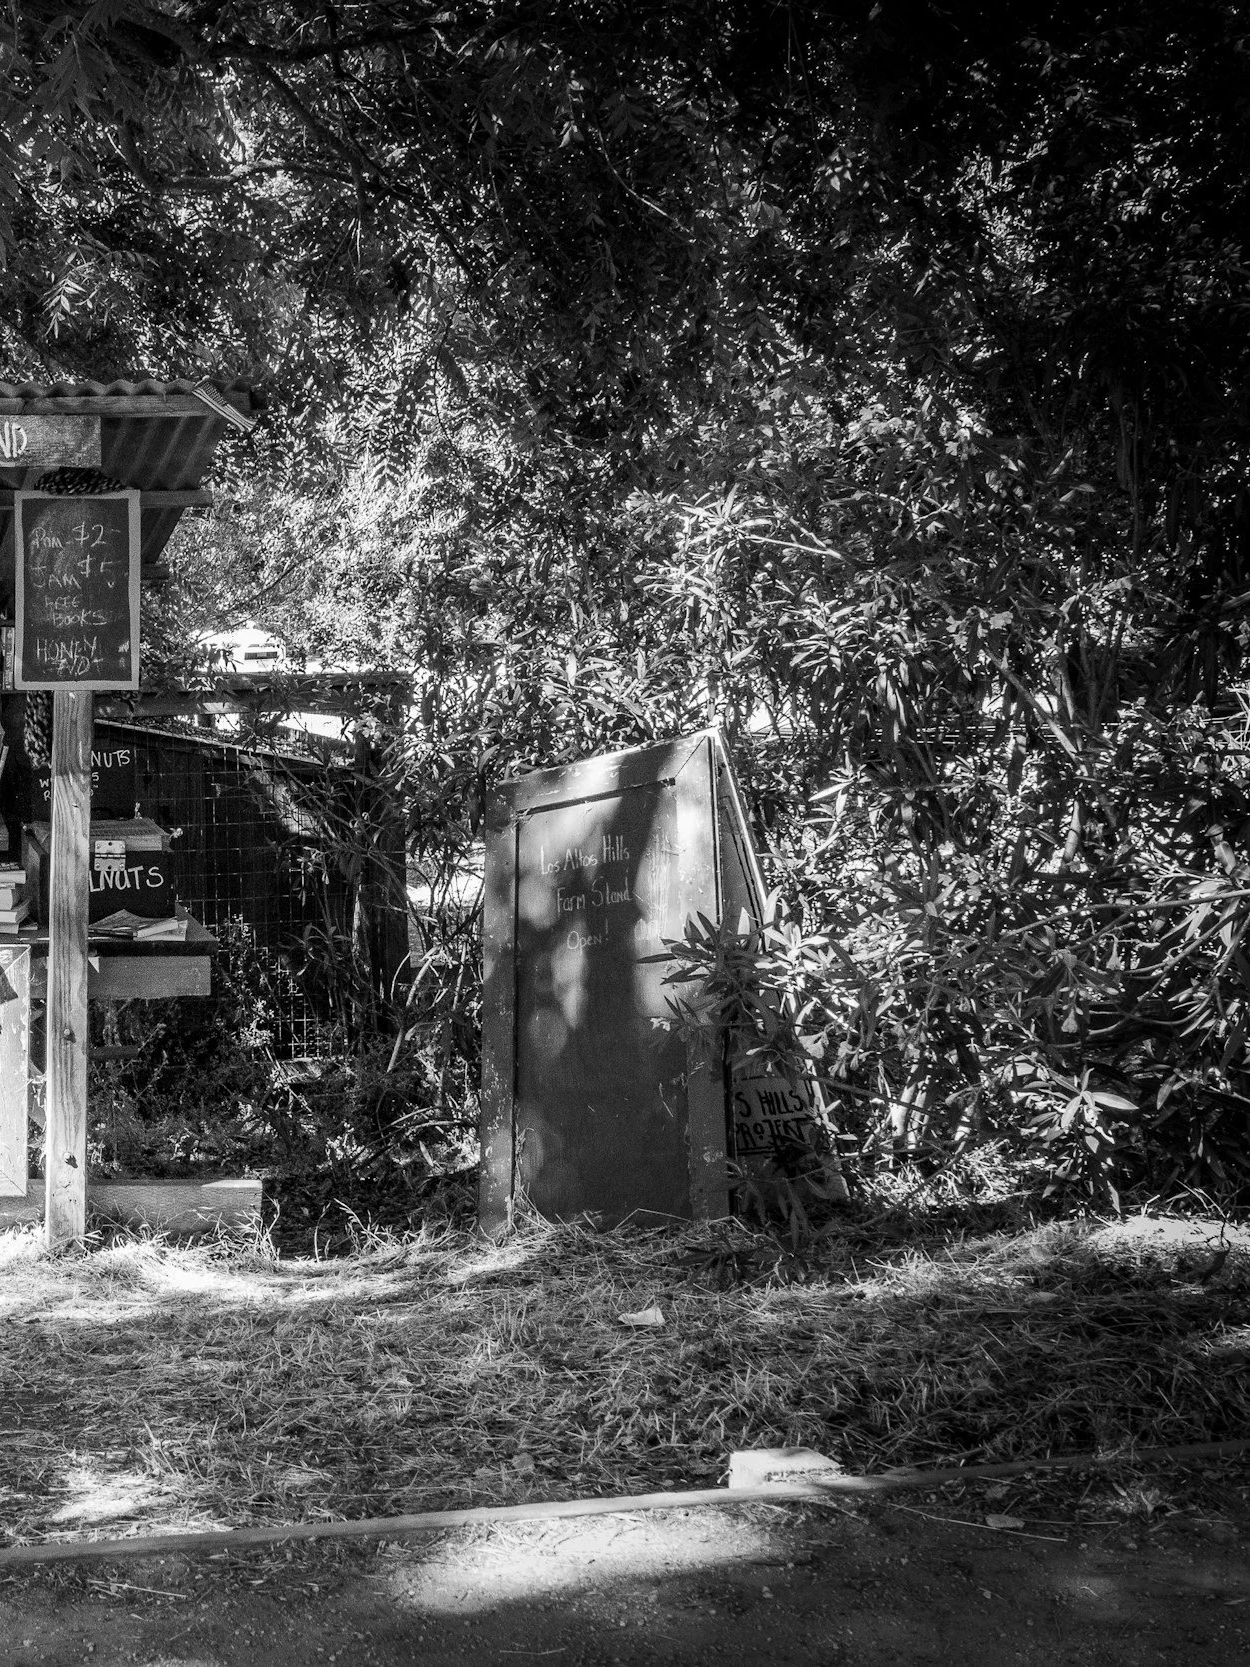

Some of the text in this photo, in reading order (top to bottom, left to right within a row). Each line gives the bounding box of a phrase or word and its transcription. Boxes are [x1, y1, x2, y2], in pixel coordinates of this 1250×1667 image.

[91, 749, 130, 768] NUTS
[541, 834, 630, 875] Los Altos Hills
[557, 876, 632, 914] Farm Stand
[756, 1089, 804, 1116] HILLS
